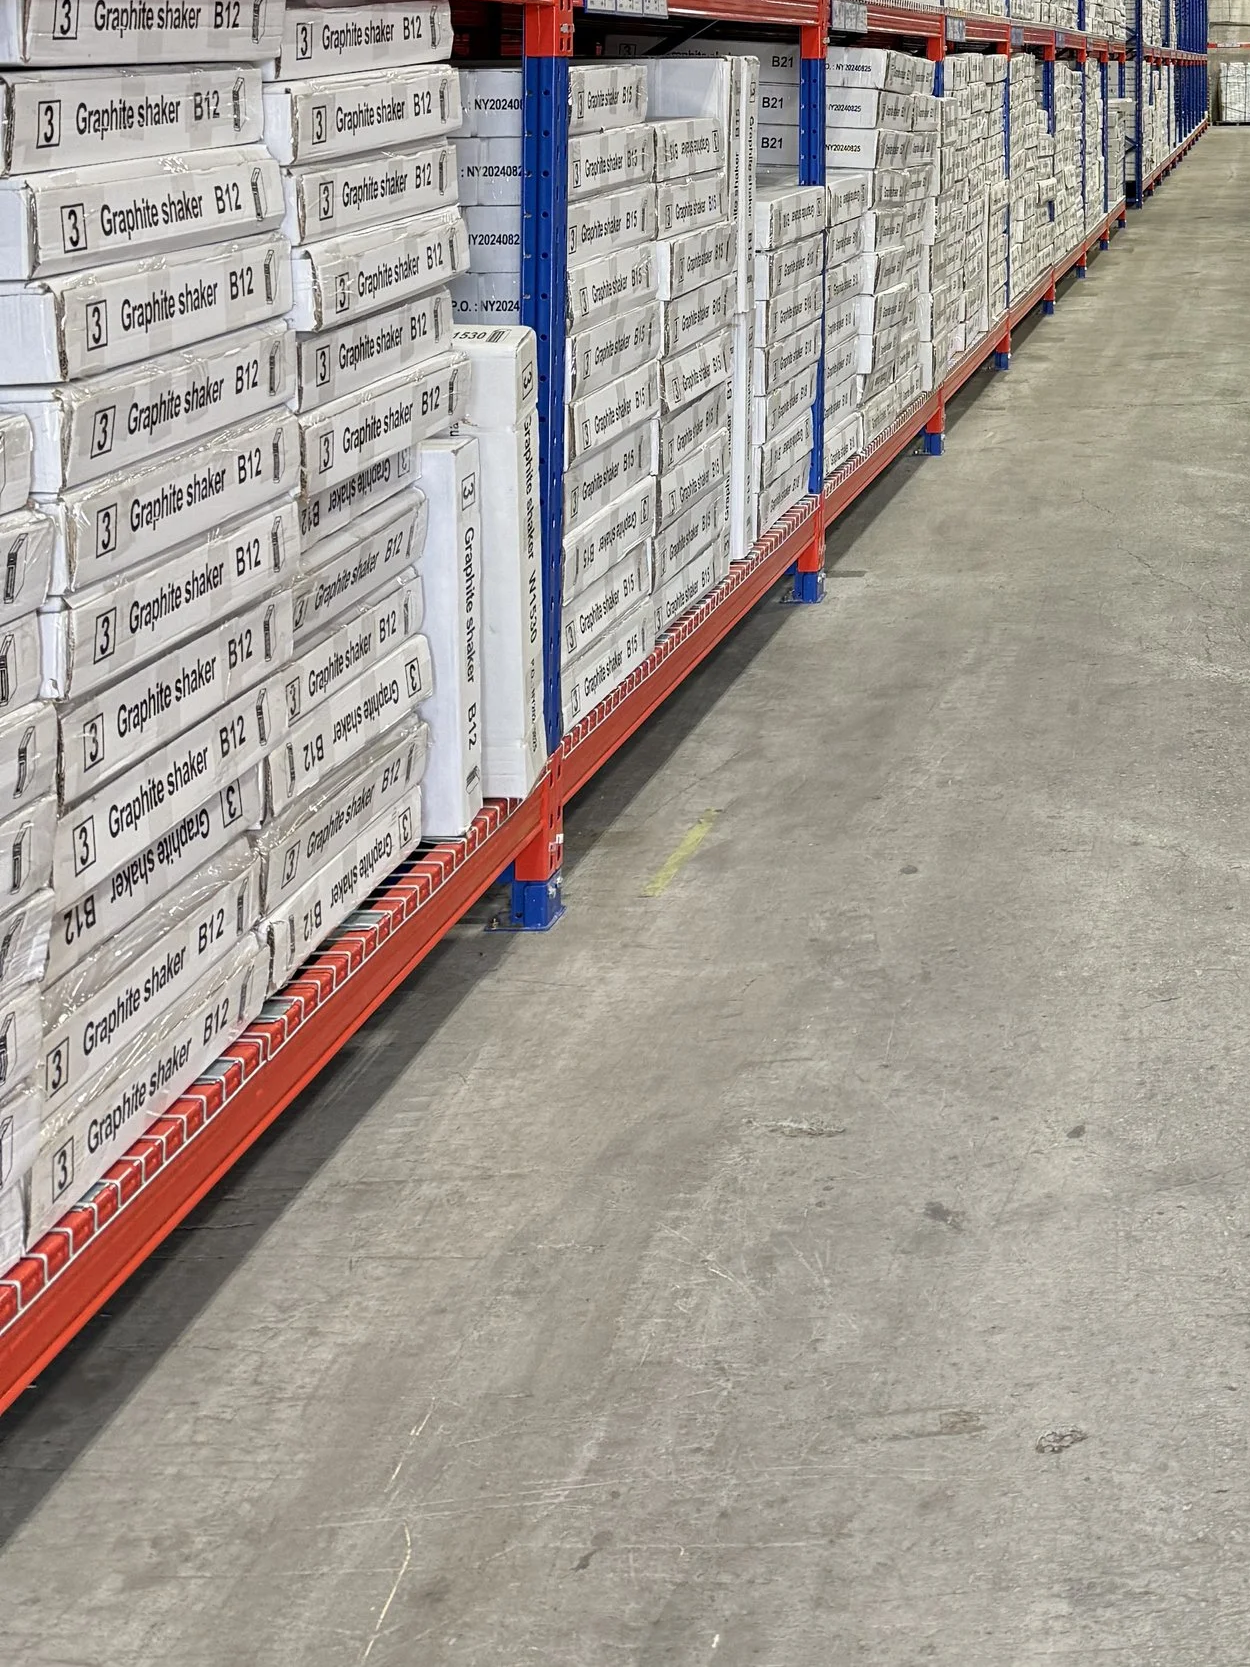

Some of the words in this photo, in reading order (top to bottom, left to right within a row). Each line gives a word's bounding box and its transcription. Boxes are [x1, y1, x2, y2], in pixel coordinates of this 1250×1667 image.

[60, 0, 71, 34] 3
[94, 0, 153, 38] Graphite
[157, 1, 201, 30] shaker
[213, 1, 241, 29] B12
[301, 26, 308, 56] 3
[322, 23, 364, 54] Graphite
[365, 19, 394, 45] shaker
[403, 15, 422, 40] B12
[772, 56, 793, 68] B21
[44, 105, 54, 142] 3
[76, 99, 134, 140] Graphite
[137, 97, 180, 127] shaker
[194, 90, 220, 121] B12
[316, 111, 323, 140] 3
[336, 102, 374, 135] Graphite
[376, 97, 405, 124] shaker
[413, 91, 432, 117] B12
[762, 96, 784, 109] B21
[761, 137, 783, 149] B21
[68, 209, 80, 247] 3
[100, 199, 159, 239] Graphite
[162, 191, 202, 225] shaker
[215, 182, 241, 214] B12
[102, 512, 111, 550] 3
[130, 485, 183, 531] Graphite
[186, 468, 226, 507] shaker
[237, 447, 262, 484] B12
[463, 483, 474, 500] 3
[464, 527, 475, 615] Graphite
[466, 619, 476, 684] shaker
[467, 702, 478, 750] B12
[78, 825, 90, 866] 3
[108, 777, 165, 838] Graphite
[167, 746, 208, 796] shaker
[219, 715, 246, 758] B12
